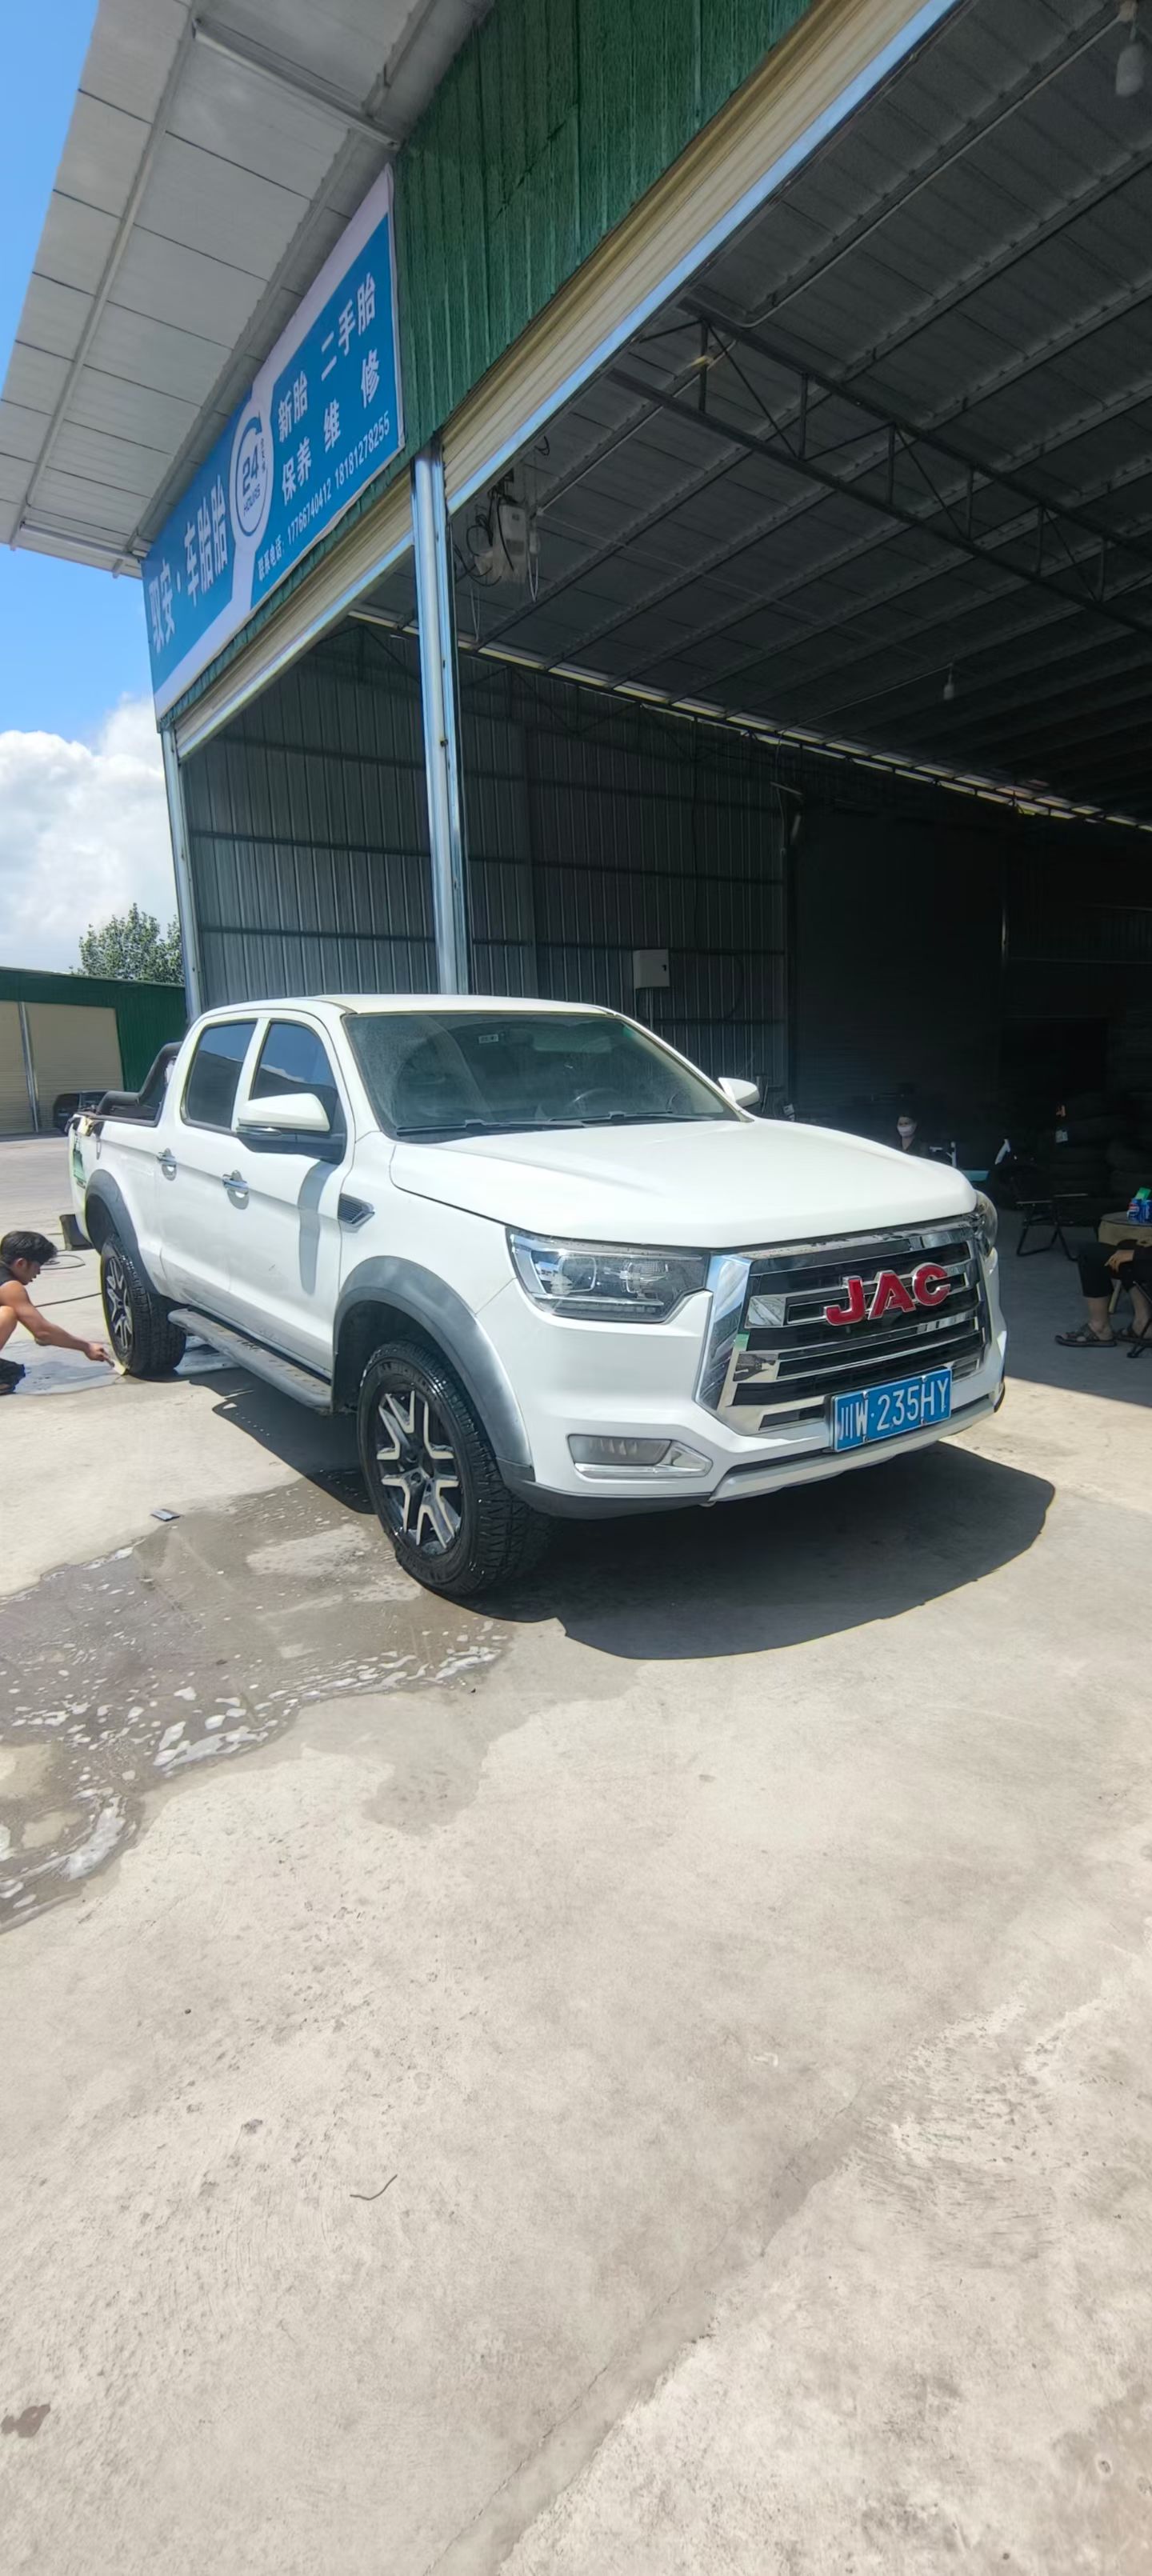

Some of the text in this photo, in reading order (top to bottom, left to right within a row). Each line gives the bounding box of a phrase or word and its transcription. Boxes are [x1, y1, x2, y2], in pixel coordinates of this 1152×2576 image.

[278, 272, 377, 443] 新胎 二手胎
[242, 445, 258, 496] 24
[282, 348, 382, 506] 保养 维 修
[243, 483, 261, 516] HOURS
[287, 478, 332, 545] 17766740412
[335, 410, 390, 489] 18181278255
[823, 1262, 950, 1326] JAC
